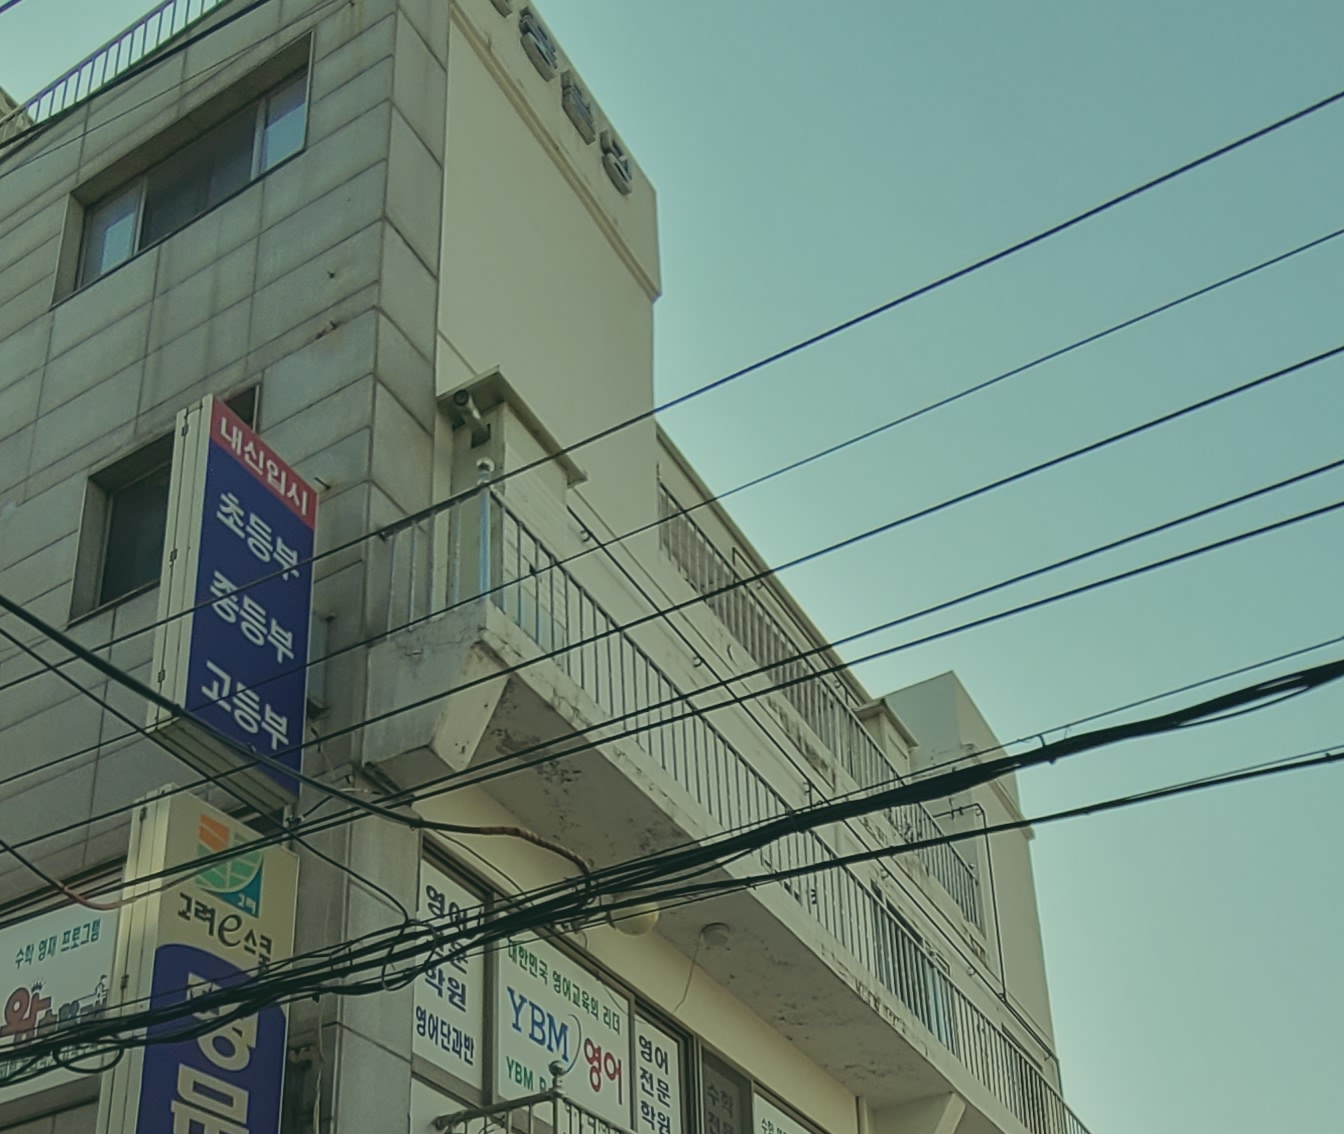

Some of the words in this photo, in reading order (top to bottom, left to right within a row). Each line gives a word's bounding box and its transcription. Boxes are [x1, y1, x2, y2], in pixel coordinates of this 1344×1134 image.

[219, 416, 310, 517] 내신입시
[216, 490, 300, 581] 초등부
[209, 569, 295, 664] 중등부
[201, 659, 289, 751] 고등부
[15, 943, 35, 970] 수학
[37, 934, 57, 961] 영재
[60, 918, 102, 954] 프로그램
[425, 967, 467, 1012] 학원
[507, 940, 549, 984] 대한민국
[552, 970, 600, 1019] 영어교육의
[603, 1005, 621, 1035] 리더
[416, 1005, 474, 1066] 영어단과반
[506, 986, 570, 1062] YBM
[584, 1037, 623, 1105] 영어
[506, 1056, 534, 1091] YBM
[639, 1034, 669, 1075] 영어
[639, 1067, 671, 1108] 전문
